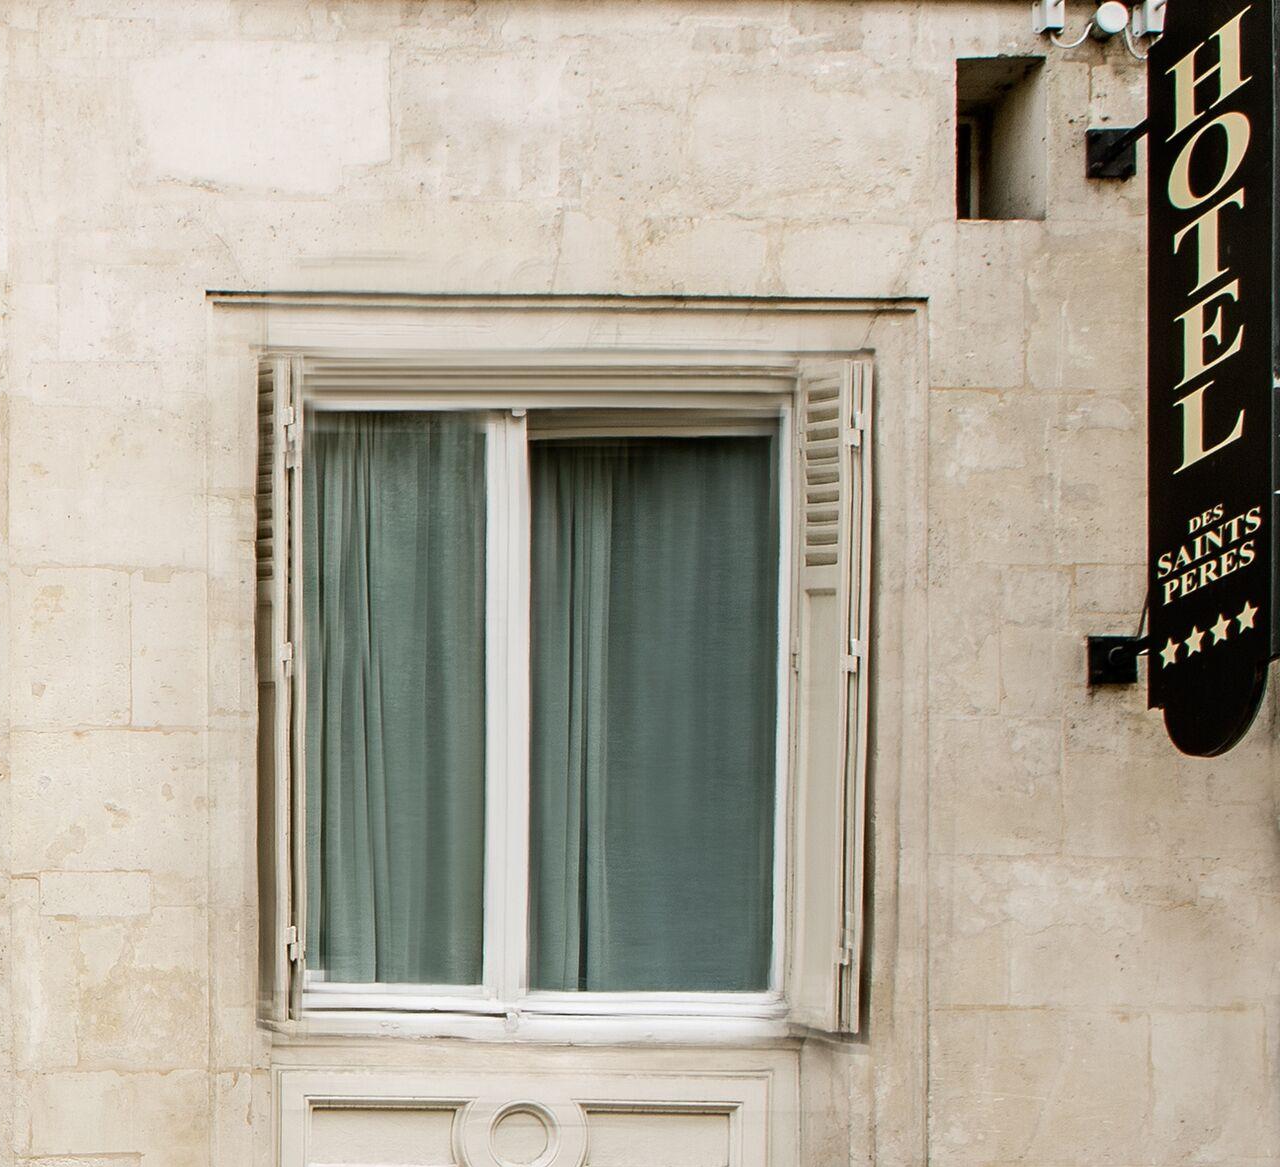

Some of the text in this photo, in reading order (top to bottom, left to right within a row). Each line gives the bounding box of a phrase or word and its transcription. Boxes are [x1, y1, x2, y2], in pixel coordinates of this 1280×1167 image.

[1165, 5, 1253, 475] HOTEL
[1157, 506, 1262, 579] SAINTS
[1188, 503, 1224, 534] DES
[1162, 540, 1256, 606] PERES
